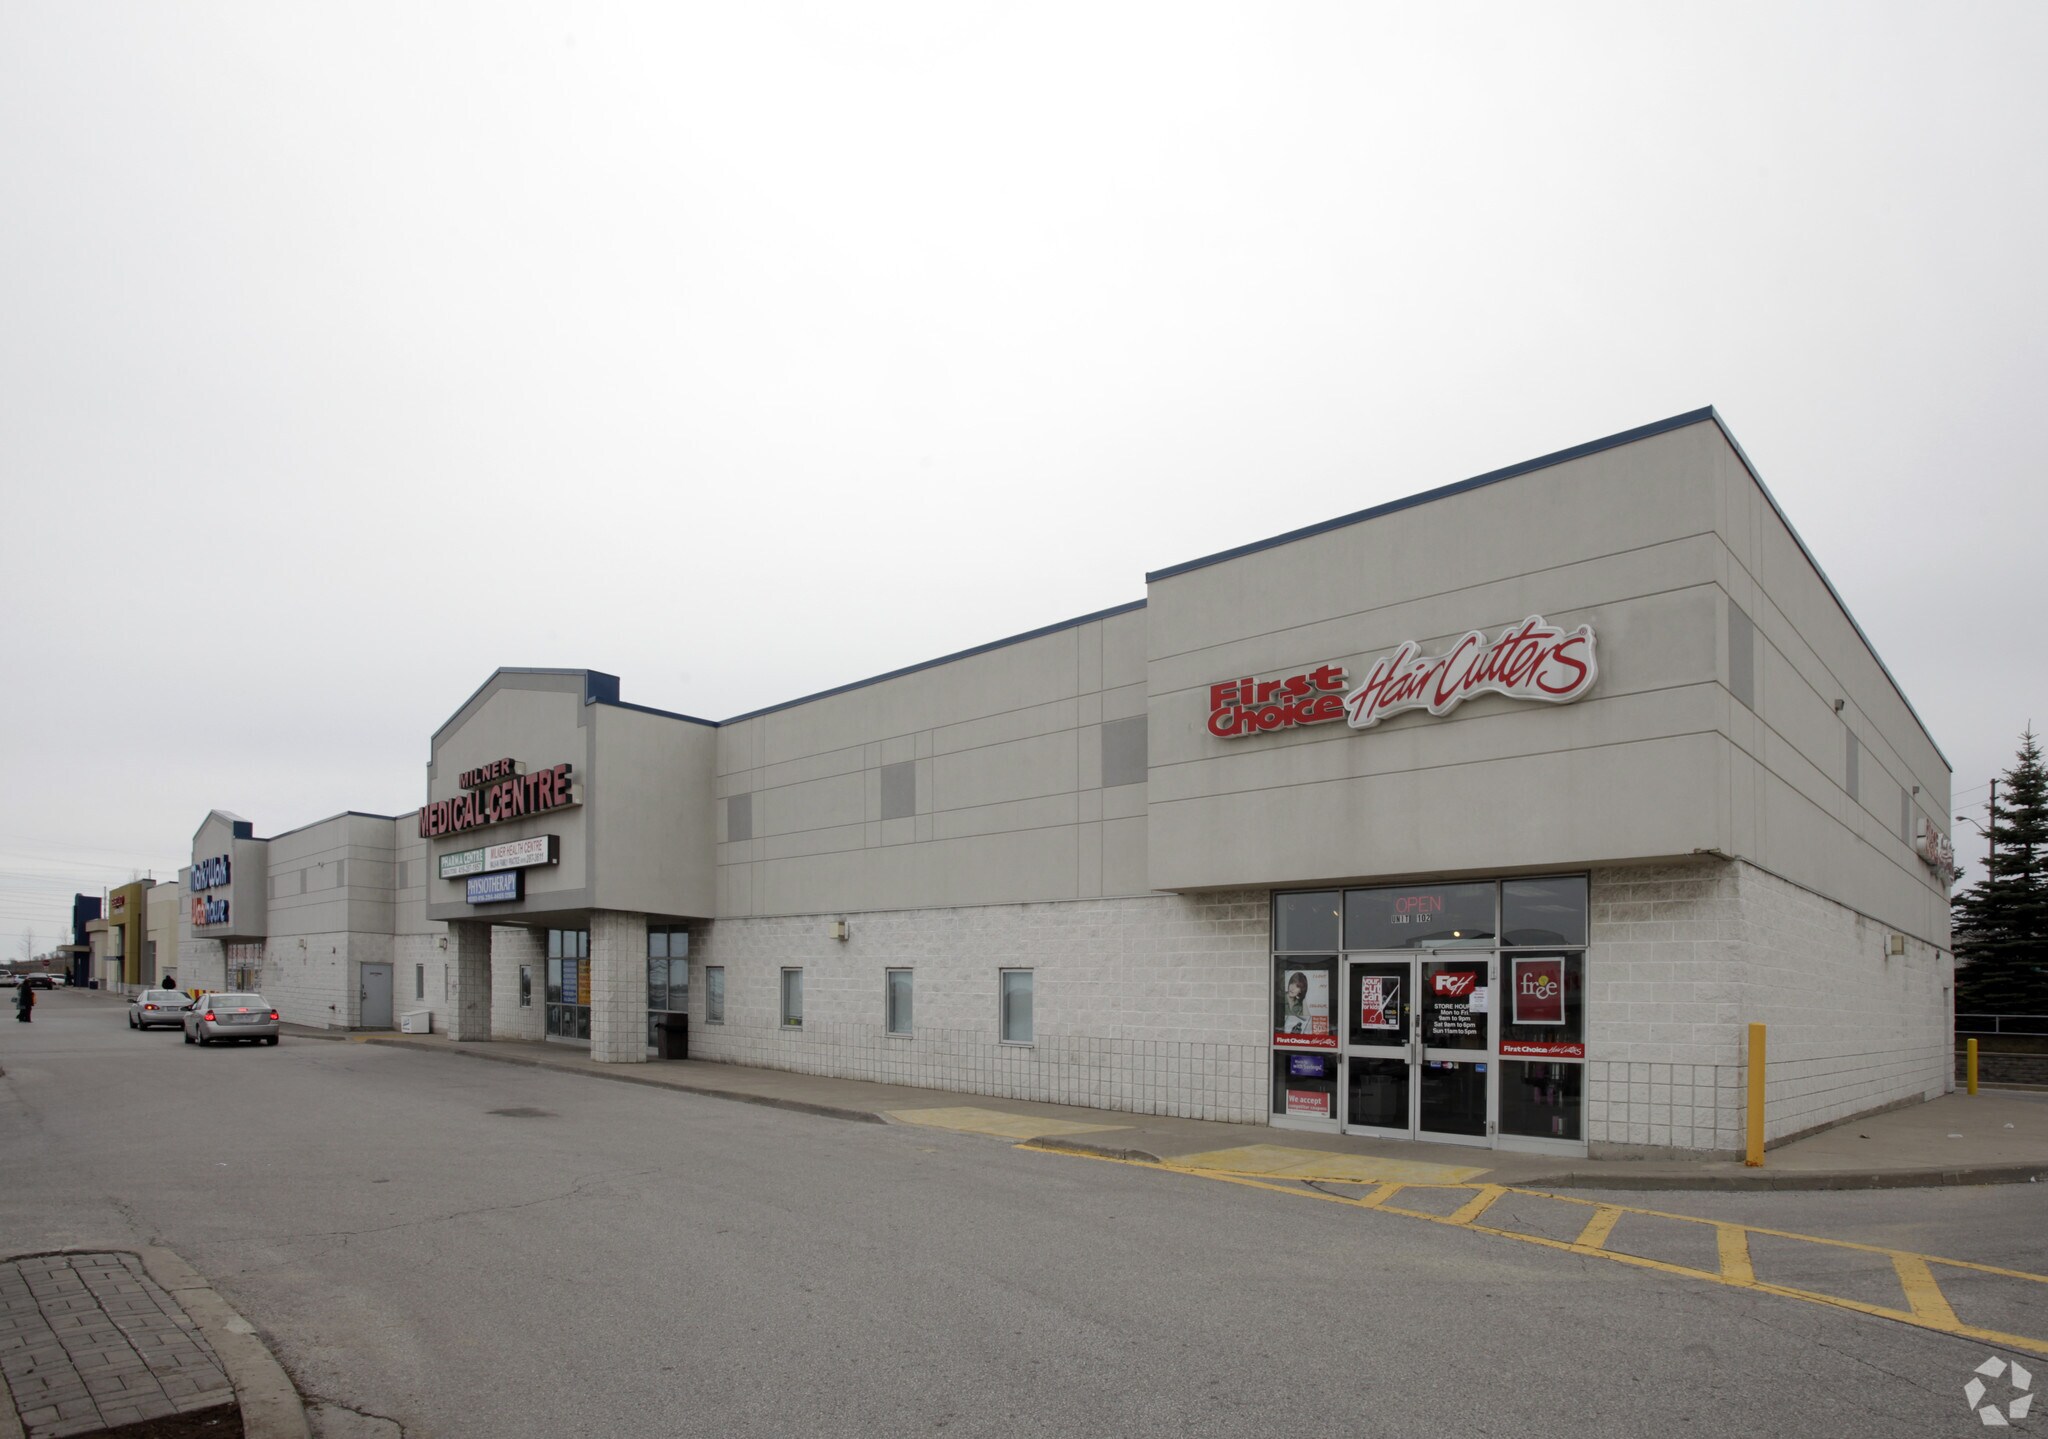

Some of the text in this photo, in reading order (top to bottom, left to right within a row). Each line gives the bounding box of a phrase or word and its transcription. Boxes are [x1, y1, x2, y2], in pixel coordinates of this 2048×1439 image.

[1210, 665, 1344, 711] First
[1207, 693, 1346, 738] Choice
[459, 757, 511, 789] MILNER
[419, 763, 568, 838] MEDICAL CENTRE
[524, 839, 543, 853] CENTRE
[464, 847, 483, 864] CENTRE
[467, 873, 516, 895] PHYSIOTHERAPY
[1395, 895, 1442, 913] OPEN
[1391, 913, 1432, 923] UNIT 102
[1363, 978, 1380, 986] your
[1363, 984, 1380, 993] cut
[1520, 972, 1558, 1000] free
[1363, 993, 1380, 1001] can
[1503, 1045, 1521, 1053] First
[1299, 1097, 1322, 1106] accept
